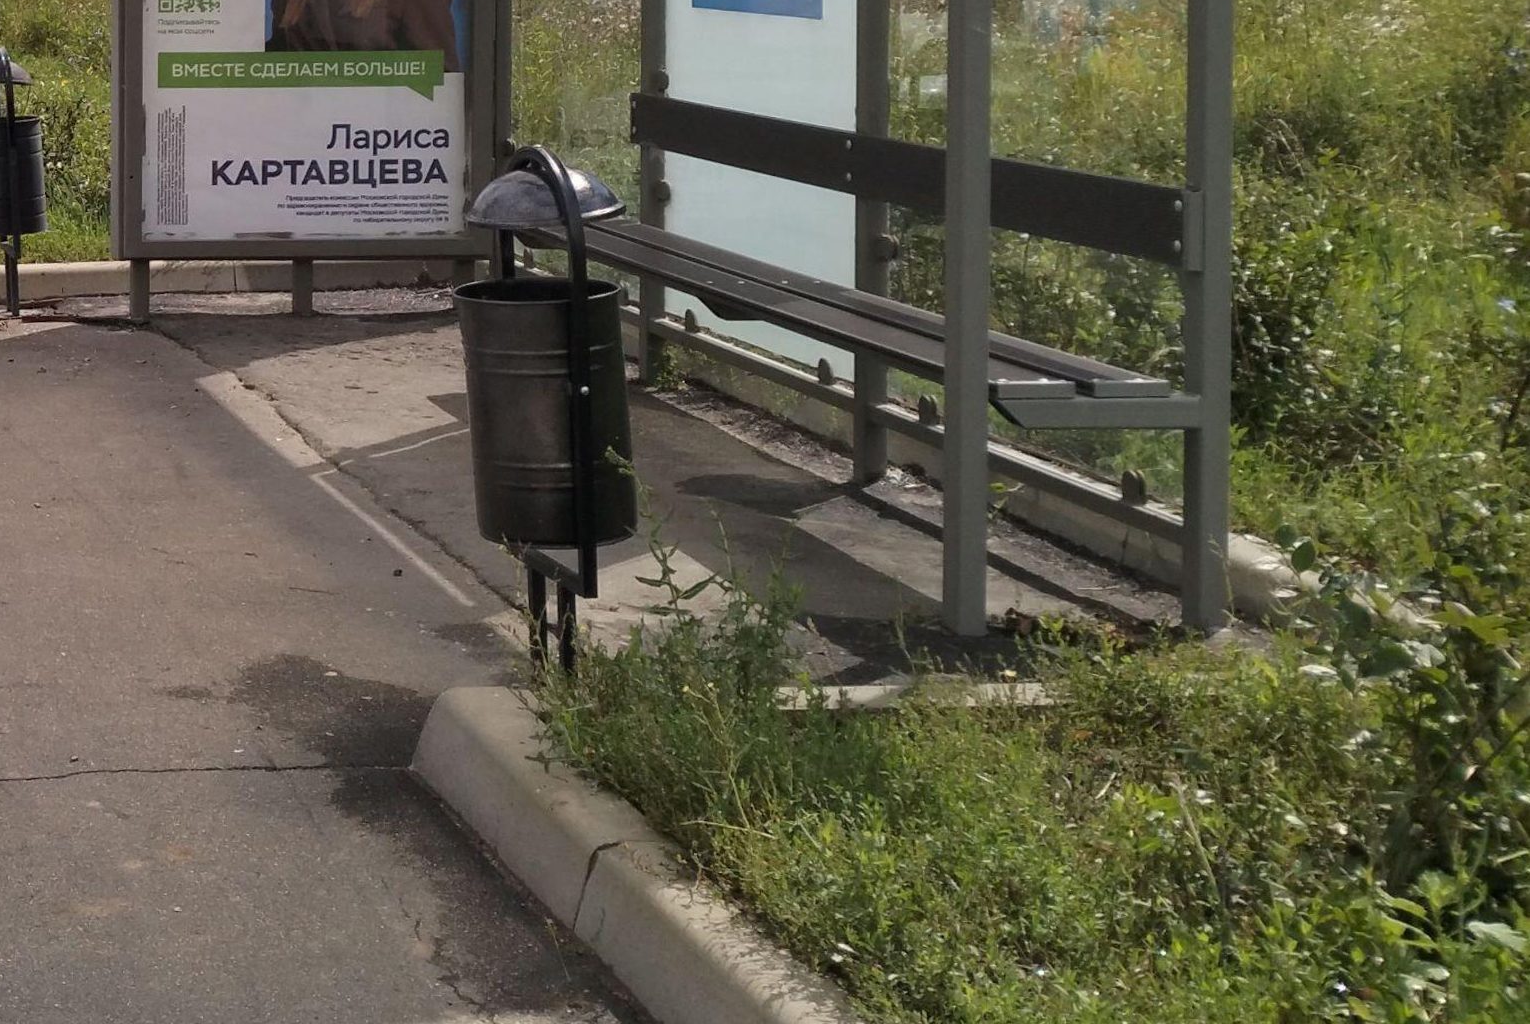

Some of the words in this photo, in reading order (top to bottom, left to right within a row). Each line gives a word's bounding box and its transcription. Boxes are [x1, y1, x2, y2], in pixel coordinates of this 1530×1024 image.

[172, 63, 246, 77] ВМЕСТЕ
[250, 62, 339, 78] СДЕЛАЕМ
[343, 60, 426, 77] БОЛЬШЕ!
[326, 124, 450, 156] Лариса
[211, 158, 449, 189] КАРТАВЦЕВА
